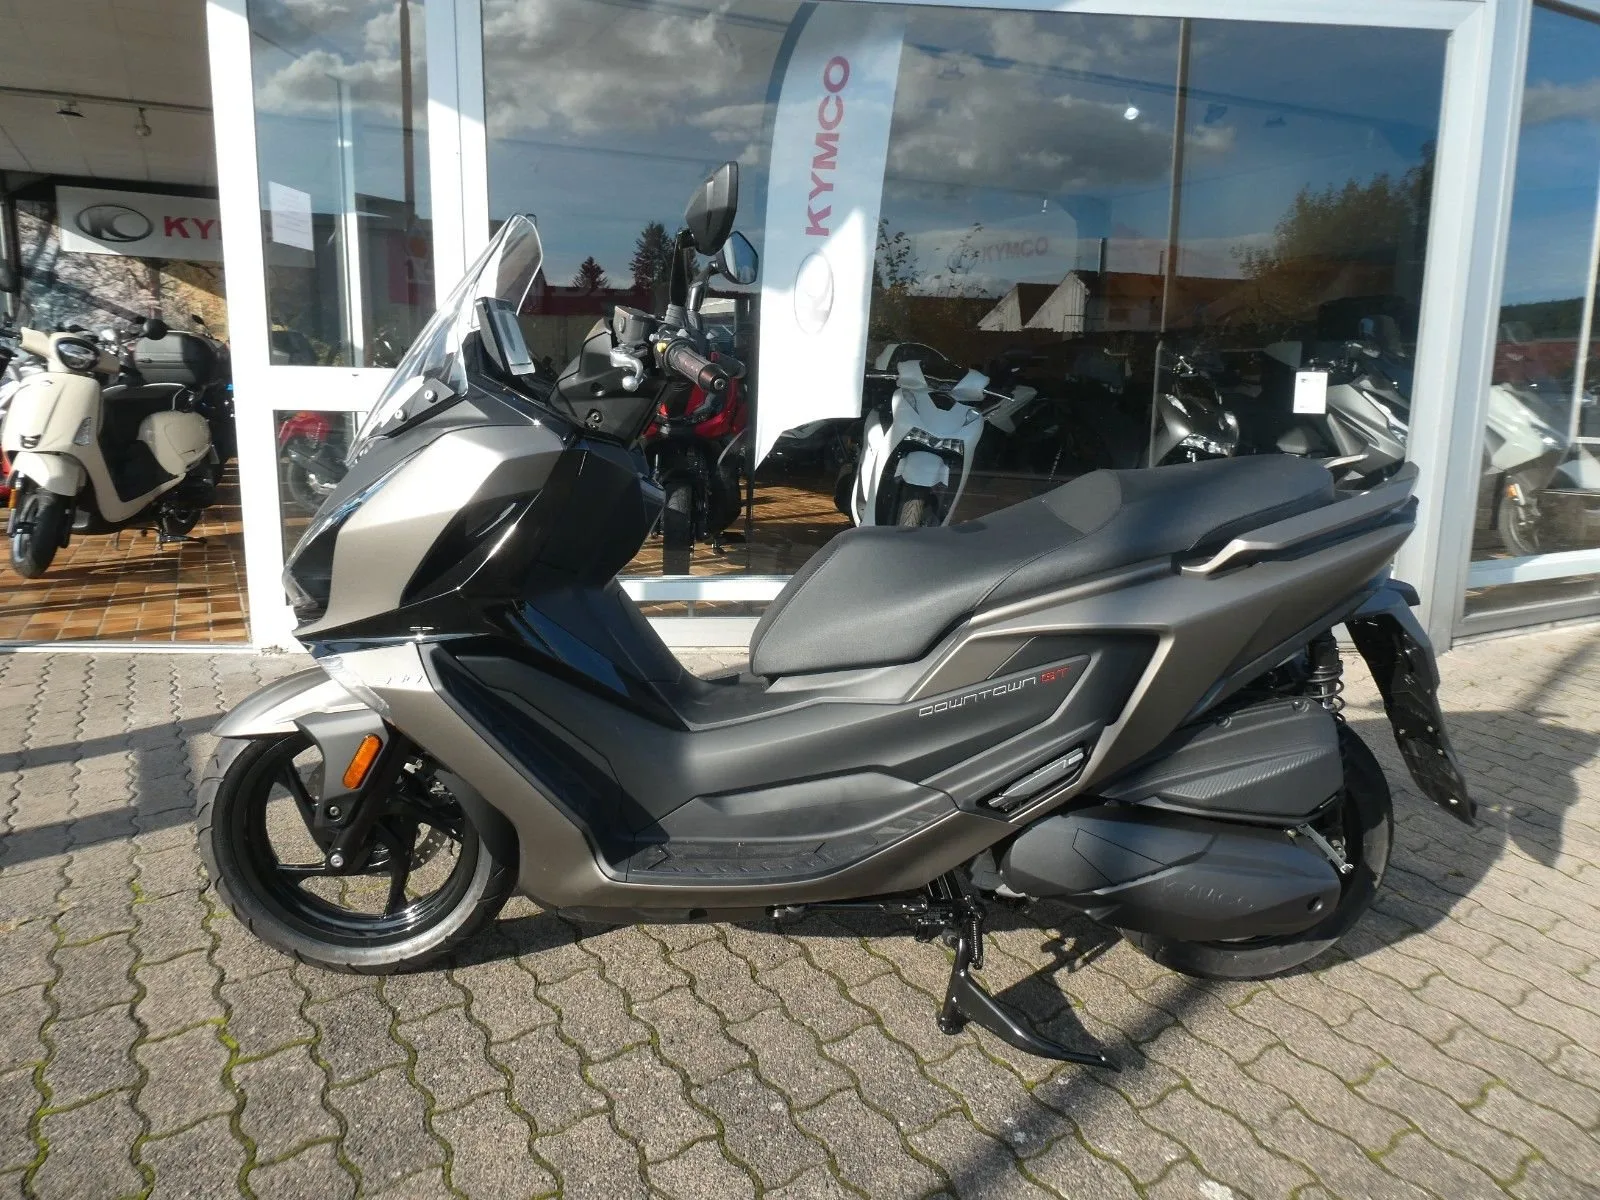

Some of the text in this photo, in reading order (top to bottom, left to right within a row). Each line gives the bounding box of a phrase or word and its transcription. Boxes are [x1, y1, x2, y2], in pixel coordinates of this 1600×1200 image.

[805, 55, 850, 237] KYMCO
[163, 215, 222, 240] KY
[918, 665, 1072, 717] DOWNTOWN GT
